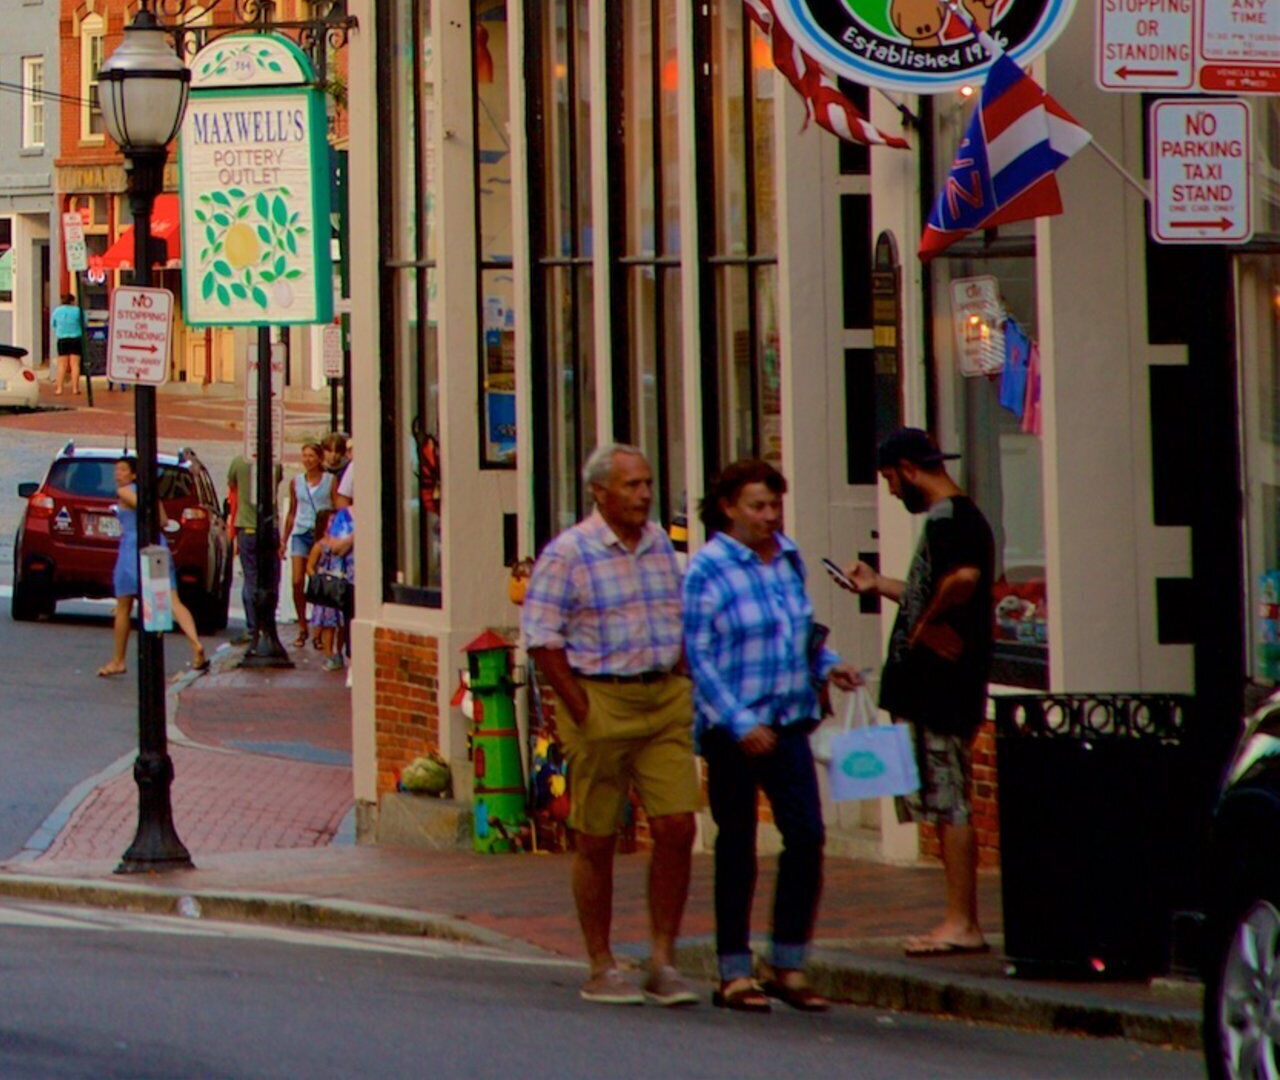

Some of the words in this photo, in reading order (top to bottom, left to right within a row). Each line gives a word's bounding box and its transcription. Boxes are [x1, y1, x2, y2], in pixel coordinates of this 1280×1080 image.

[1232, 0, 1267, 9] ANY
[1231, 12, 1267, 24] TIME
[1136, 20, 1159, 36] OR
[843, 26, 960, 68] Established
[1106, 44, 1190, 61] STANDING
[193, 109, 305, 146] MAXWELL'S
[1185, 113, 1216, 136] NO
[1161, 141, 1242, 157] PARKING
[214, 149, 285, 167] POTTERY
[218, 167, 282, 186] OUTLET
[1182, 164, 1222, 180] TAXI
[1172, 185, 1233, 202] STAND
[132, 296, 153, 309] NO
[117, 309, 166, 322] STOPPING
[135, 322, 148, 330] OR
[116, 330, 166, 342] STANDING
[127, 366, 149, 375] ZONE
